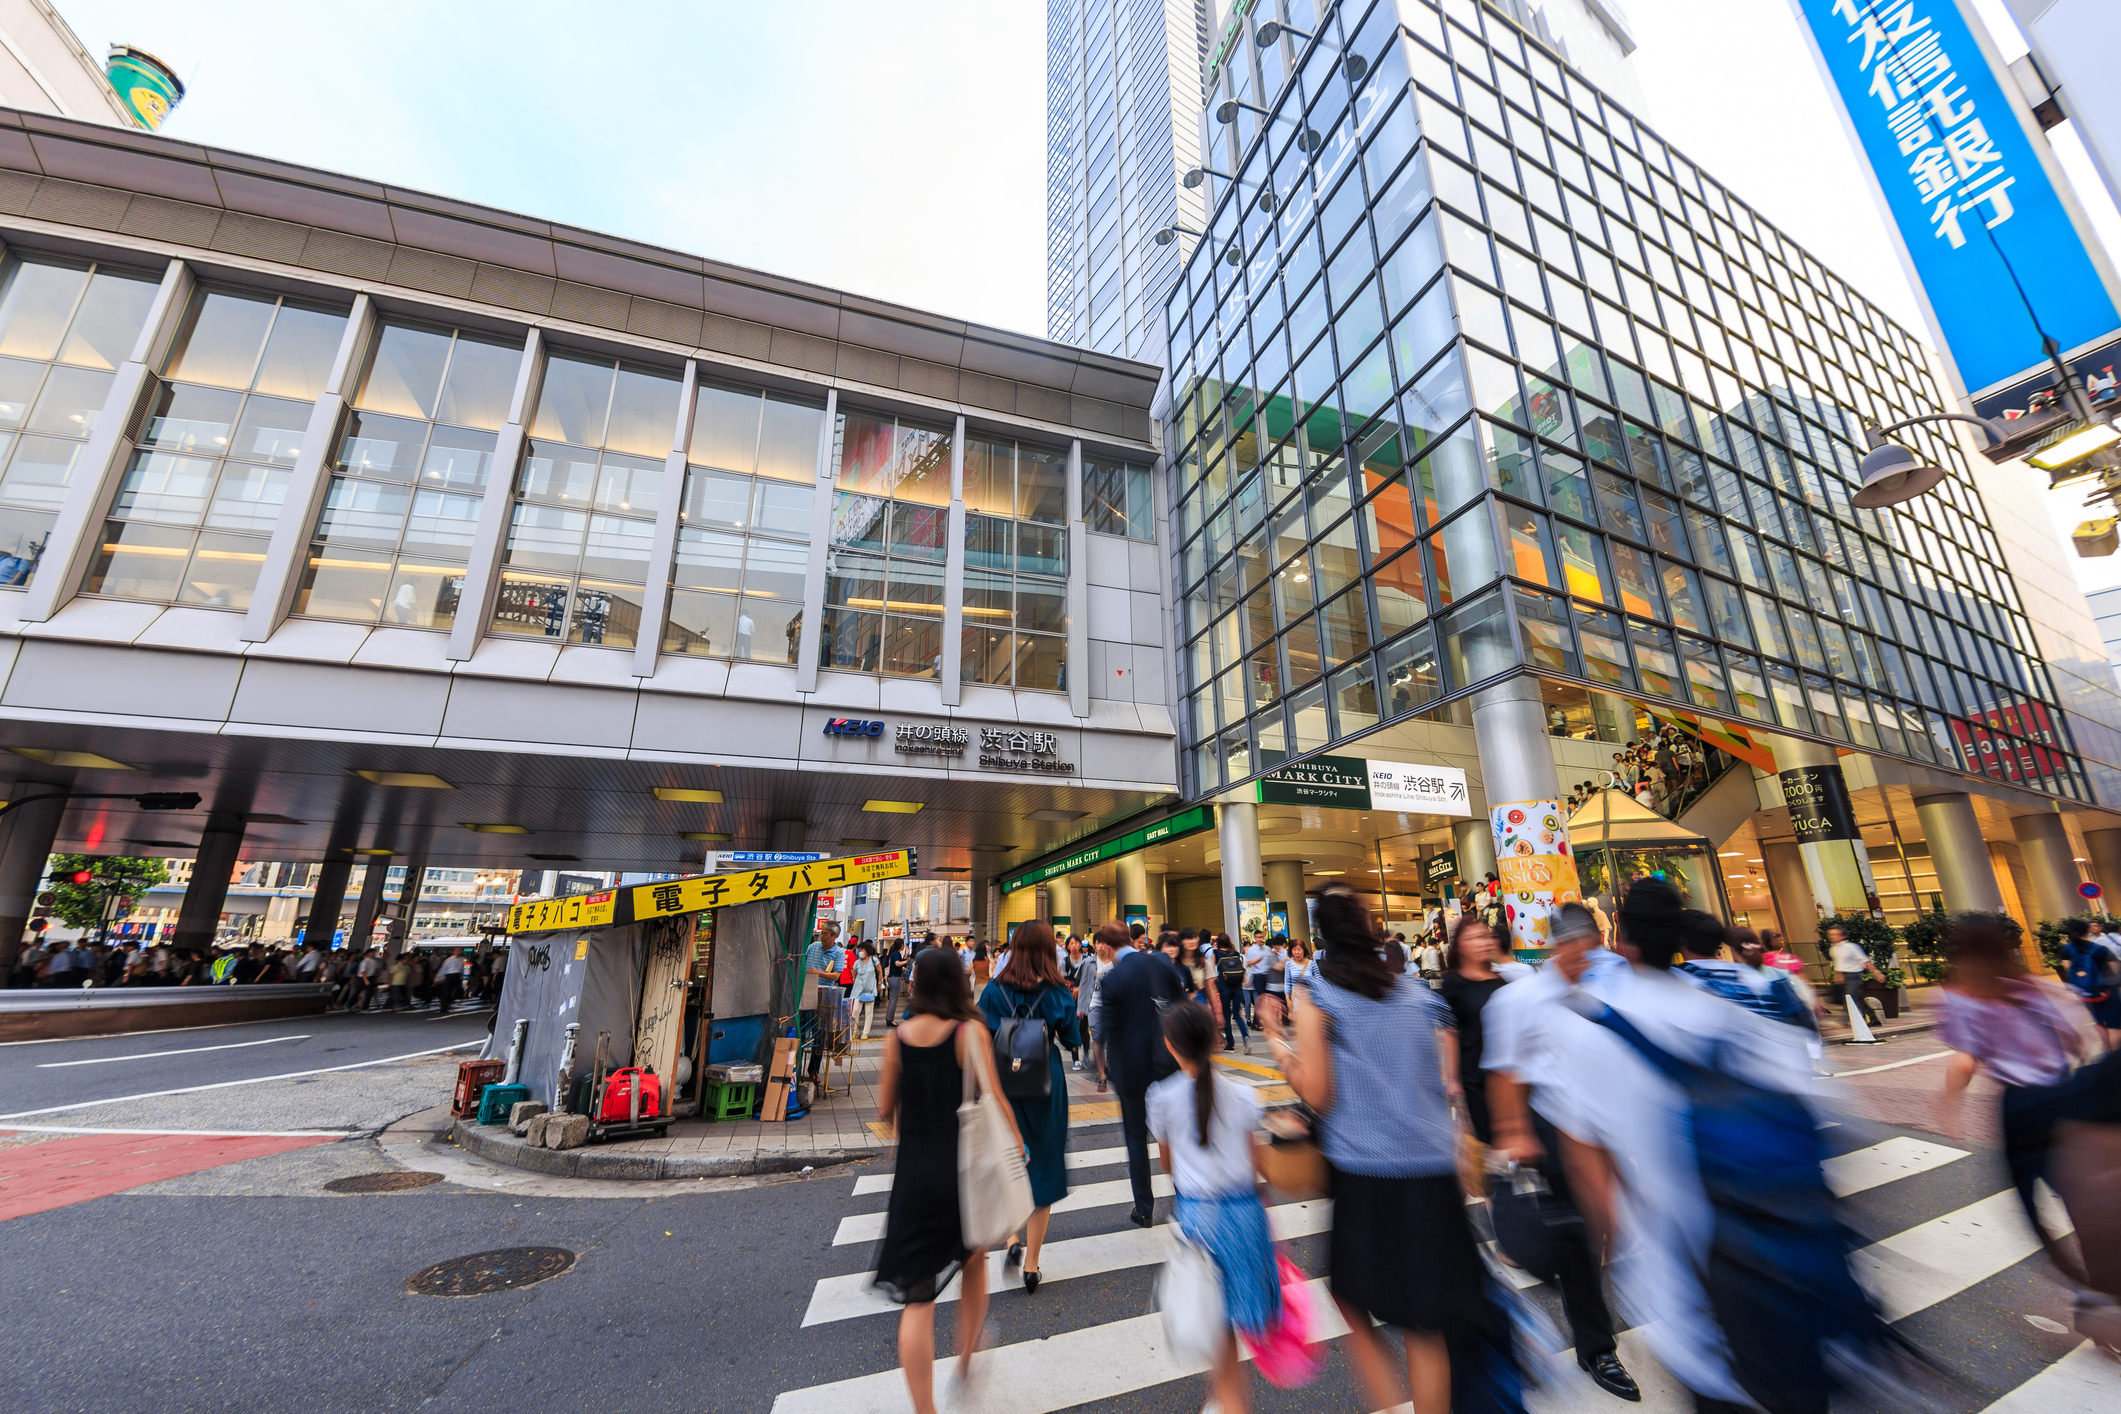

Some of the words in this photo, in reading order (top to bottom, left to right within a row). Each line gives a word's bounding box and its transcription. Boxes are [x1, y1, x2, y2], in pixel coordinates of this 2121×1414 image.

[823, 717, 885, 737] KEIO
[896, 722, 969, 744] 井の頭線
[980, 727, 1056, 754] 渋谷駅
[979, 755, 1028, 770] Shibuya
[1031, 758, 1075, 772] Station
[1291, 763, 1338, 773] SHIBUYA
[1267, 771, 1318, 783] MARK
[1322, 773, 1363, 786] CITY
[1372, 771, 1393, 780] KEIO
[1373, 781, 1400, 791] 井の頭線
[1403, 775, 1446, 794] 渋谷駅
[1296, 787, 1338, 797] 渋谷マークシティ
[746, 853, 772, 861] 渋谷駅
[782, 854, 805, 862] Shibuya
[1045, 864, 1065, 876] SHIBUYA
[1067, 857, 1082, 868] MARK
[1084, 850, 1099, 863] CITY
[652, 864, 847, 913] 電子タバコ
[513, 902, 580, 930] 電子タバコ
